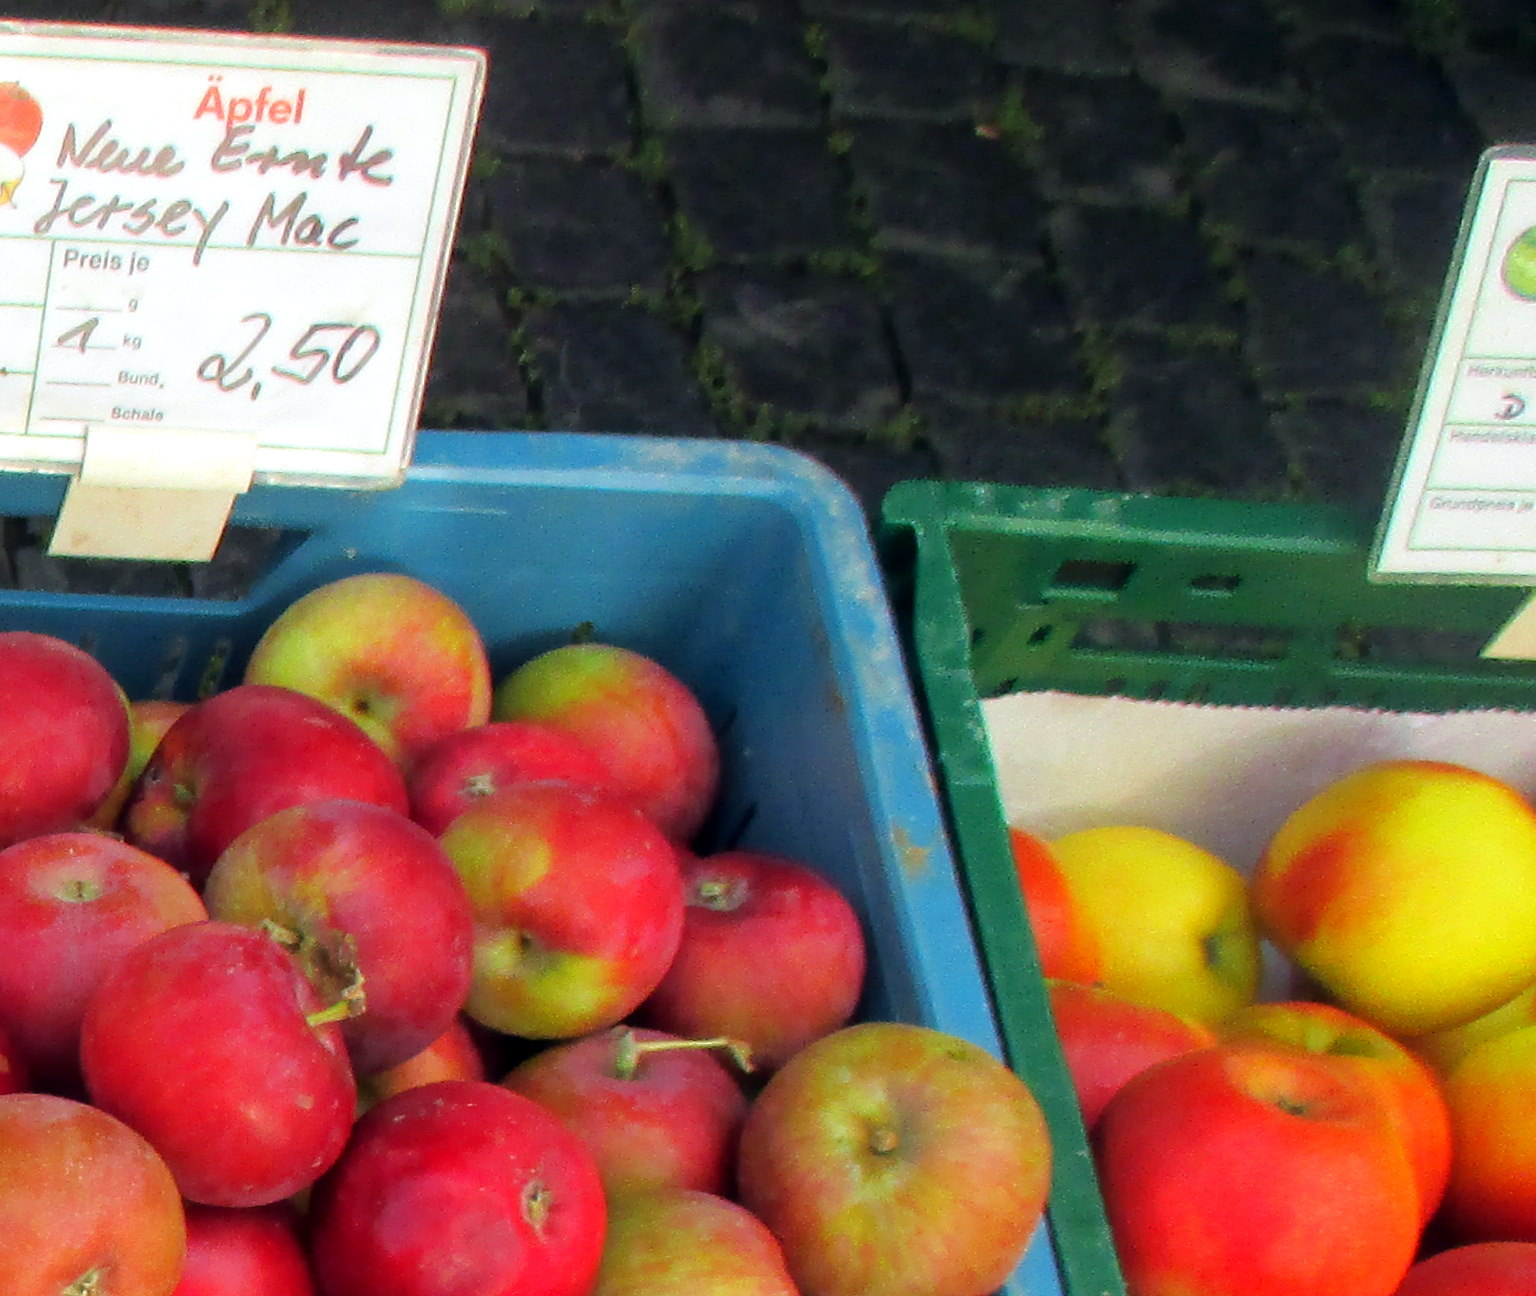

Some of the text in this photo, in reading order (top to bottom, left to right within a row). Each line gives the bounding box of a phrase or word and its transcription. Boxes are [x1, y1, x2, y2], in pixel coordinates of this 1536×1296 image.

[193, 74, 305, 137] Äpfel
[57, 120, 186, 177] Neue
[32, 178, 361, 267] Jersey Mac
[63, 248, 150, 275] Preis je
[122, 333, 142, 350] kg
[197, 312, 382, 400] 2,50
